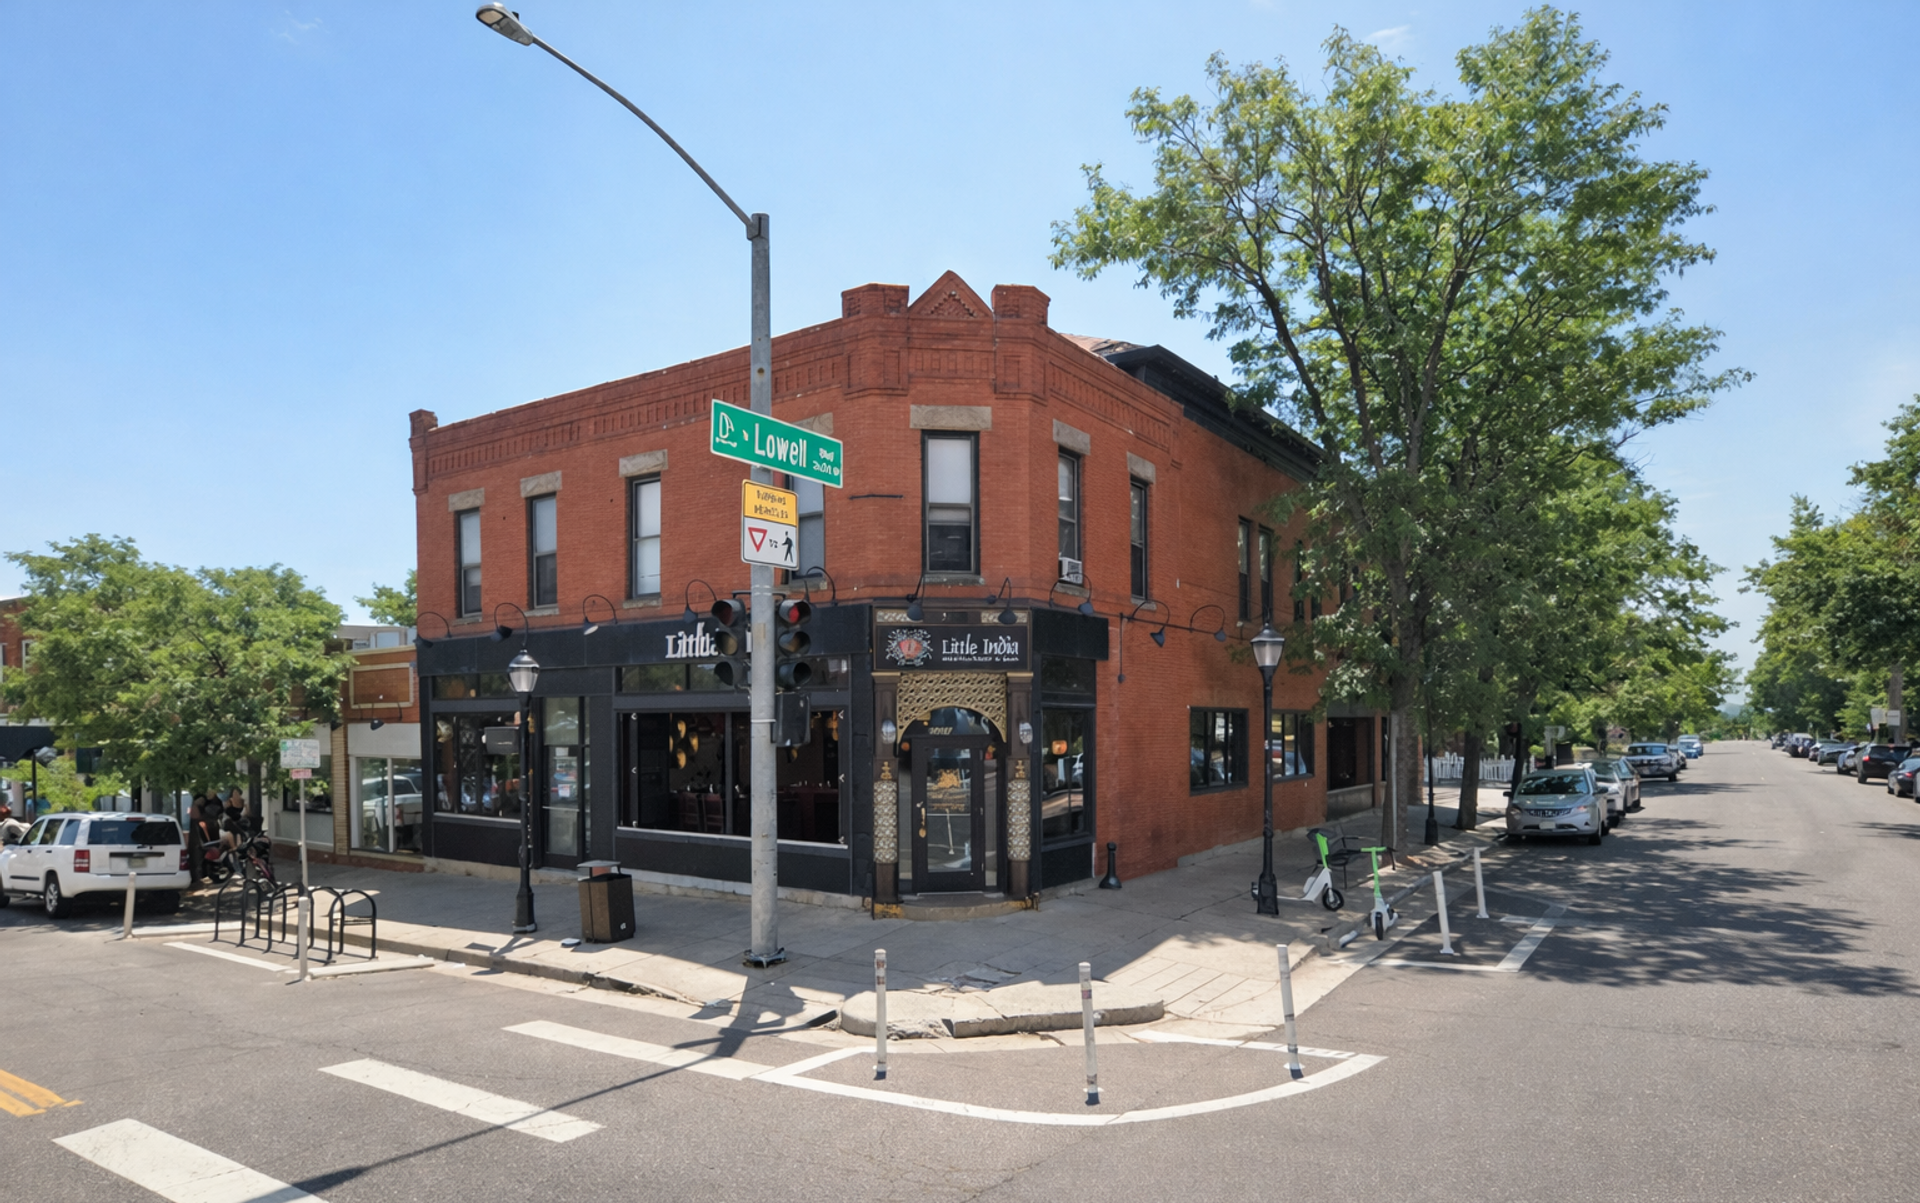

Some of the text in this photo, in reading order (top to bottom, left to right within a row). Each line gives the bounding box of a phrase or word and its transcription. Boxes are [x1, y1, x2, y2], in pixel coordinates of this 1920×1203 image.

[754, 423, 807, 468] Lowell
[942, 633, 1019, 655] Little India
